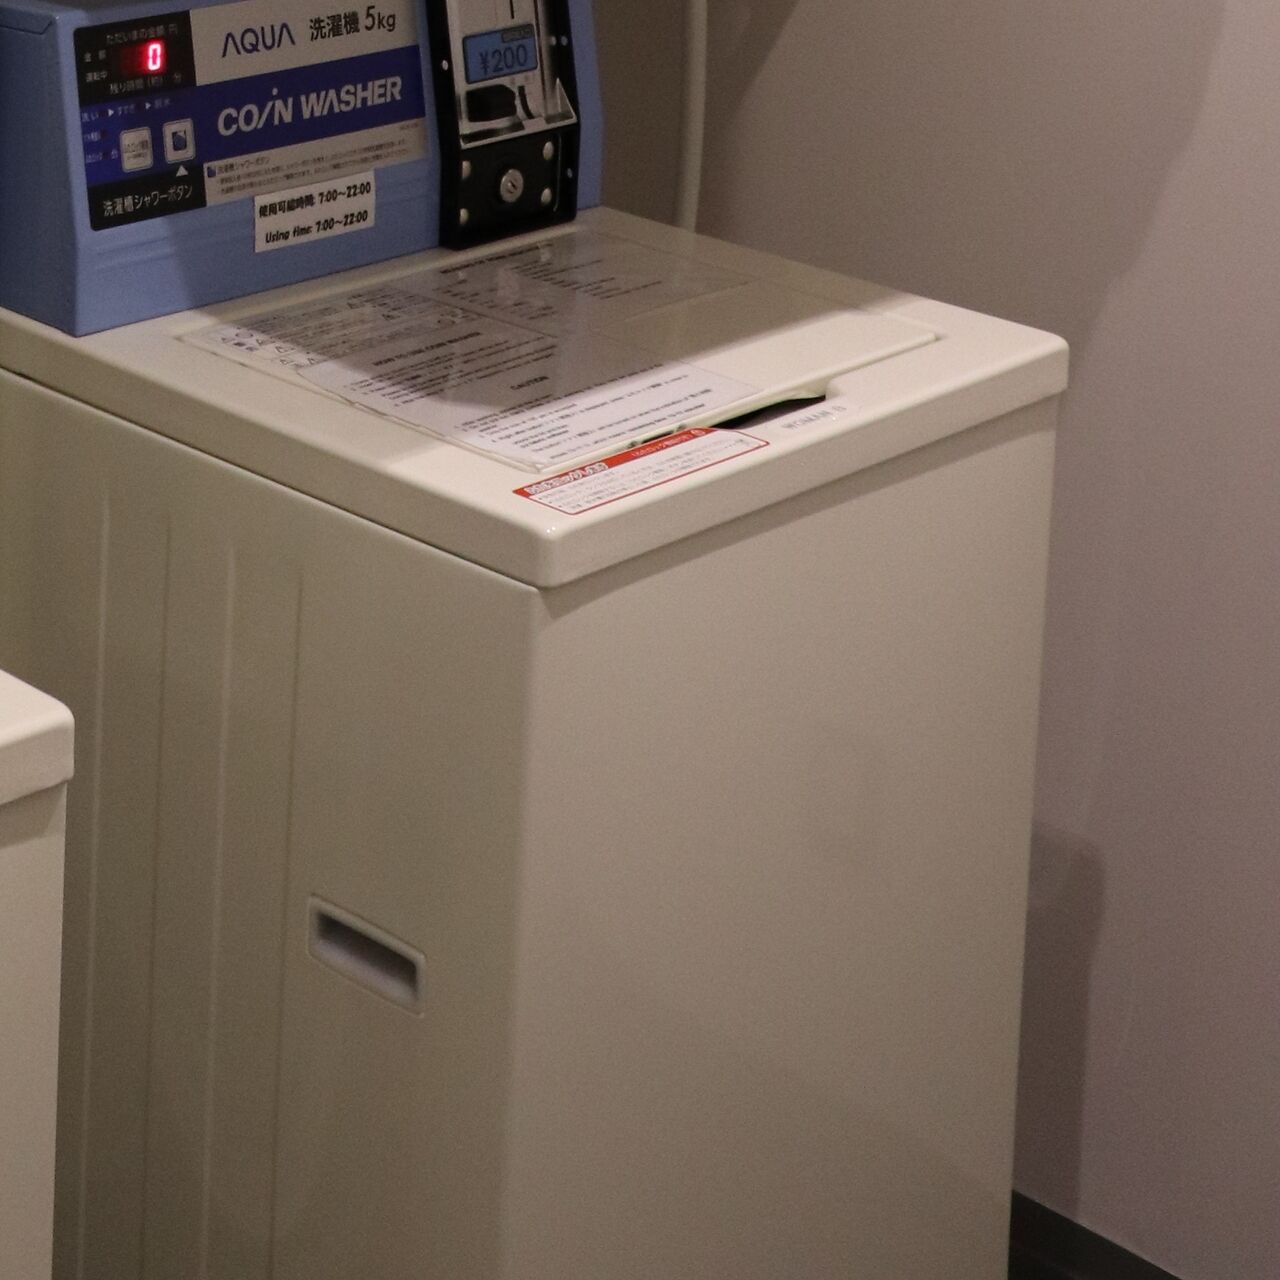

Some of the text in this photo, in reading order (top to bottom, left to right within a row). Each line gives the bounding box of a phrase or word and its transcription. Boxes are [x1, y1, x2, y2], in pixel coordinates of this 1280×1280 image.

[309, 10, 360, 41] 洗濯機
[364, 6, 396, 32] 5kg
[221, 23, 296, 58] AQUA
[148, 43, 162, 71] 0
[479, 44, 528, 76] ¥200
[300, 76, 402, 120] WASHER
[265, 229, 290, 244] Using
